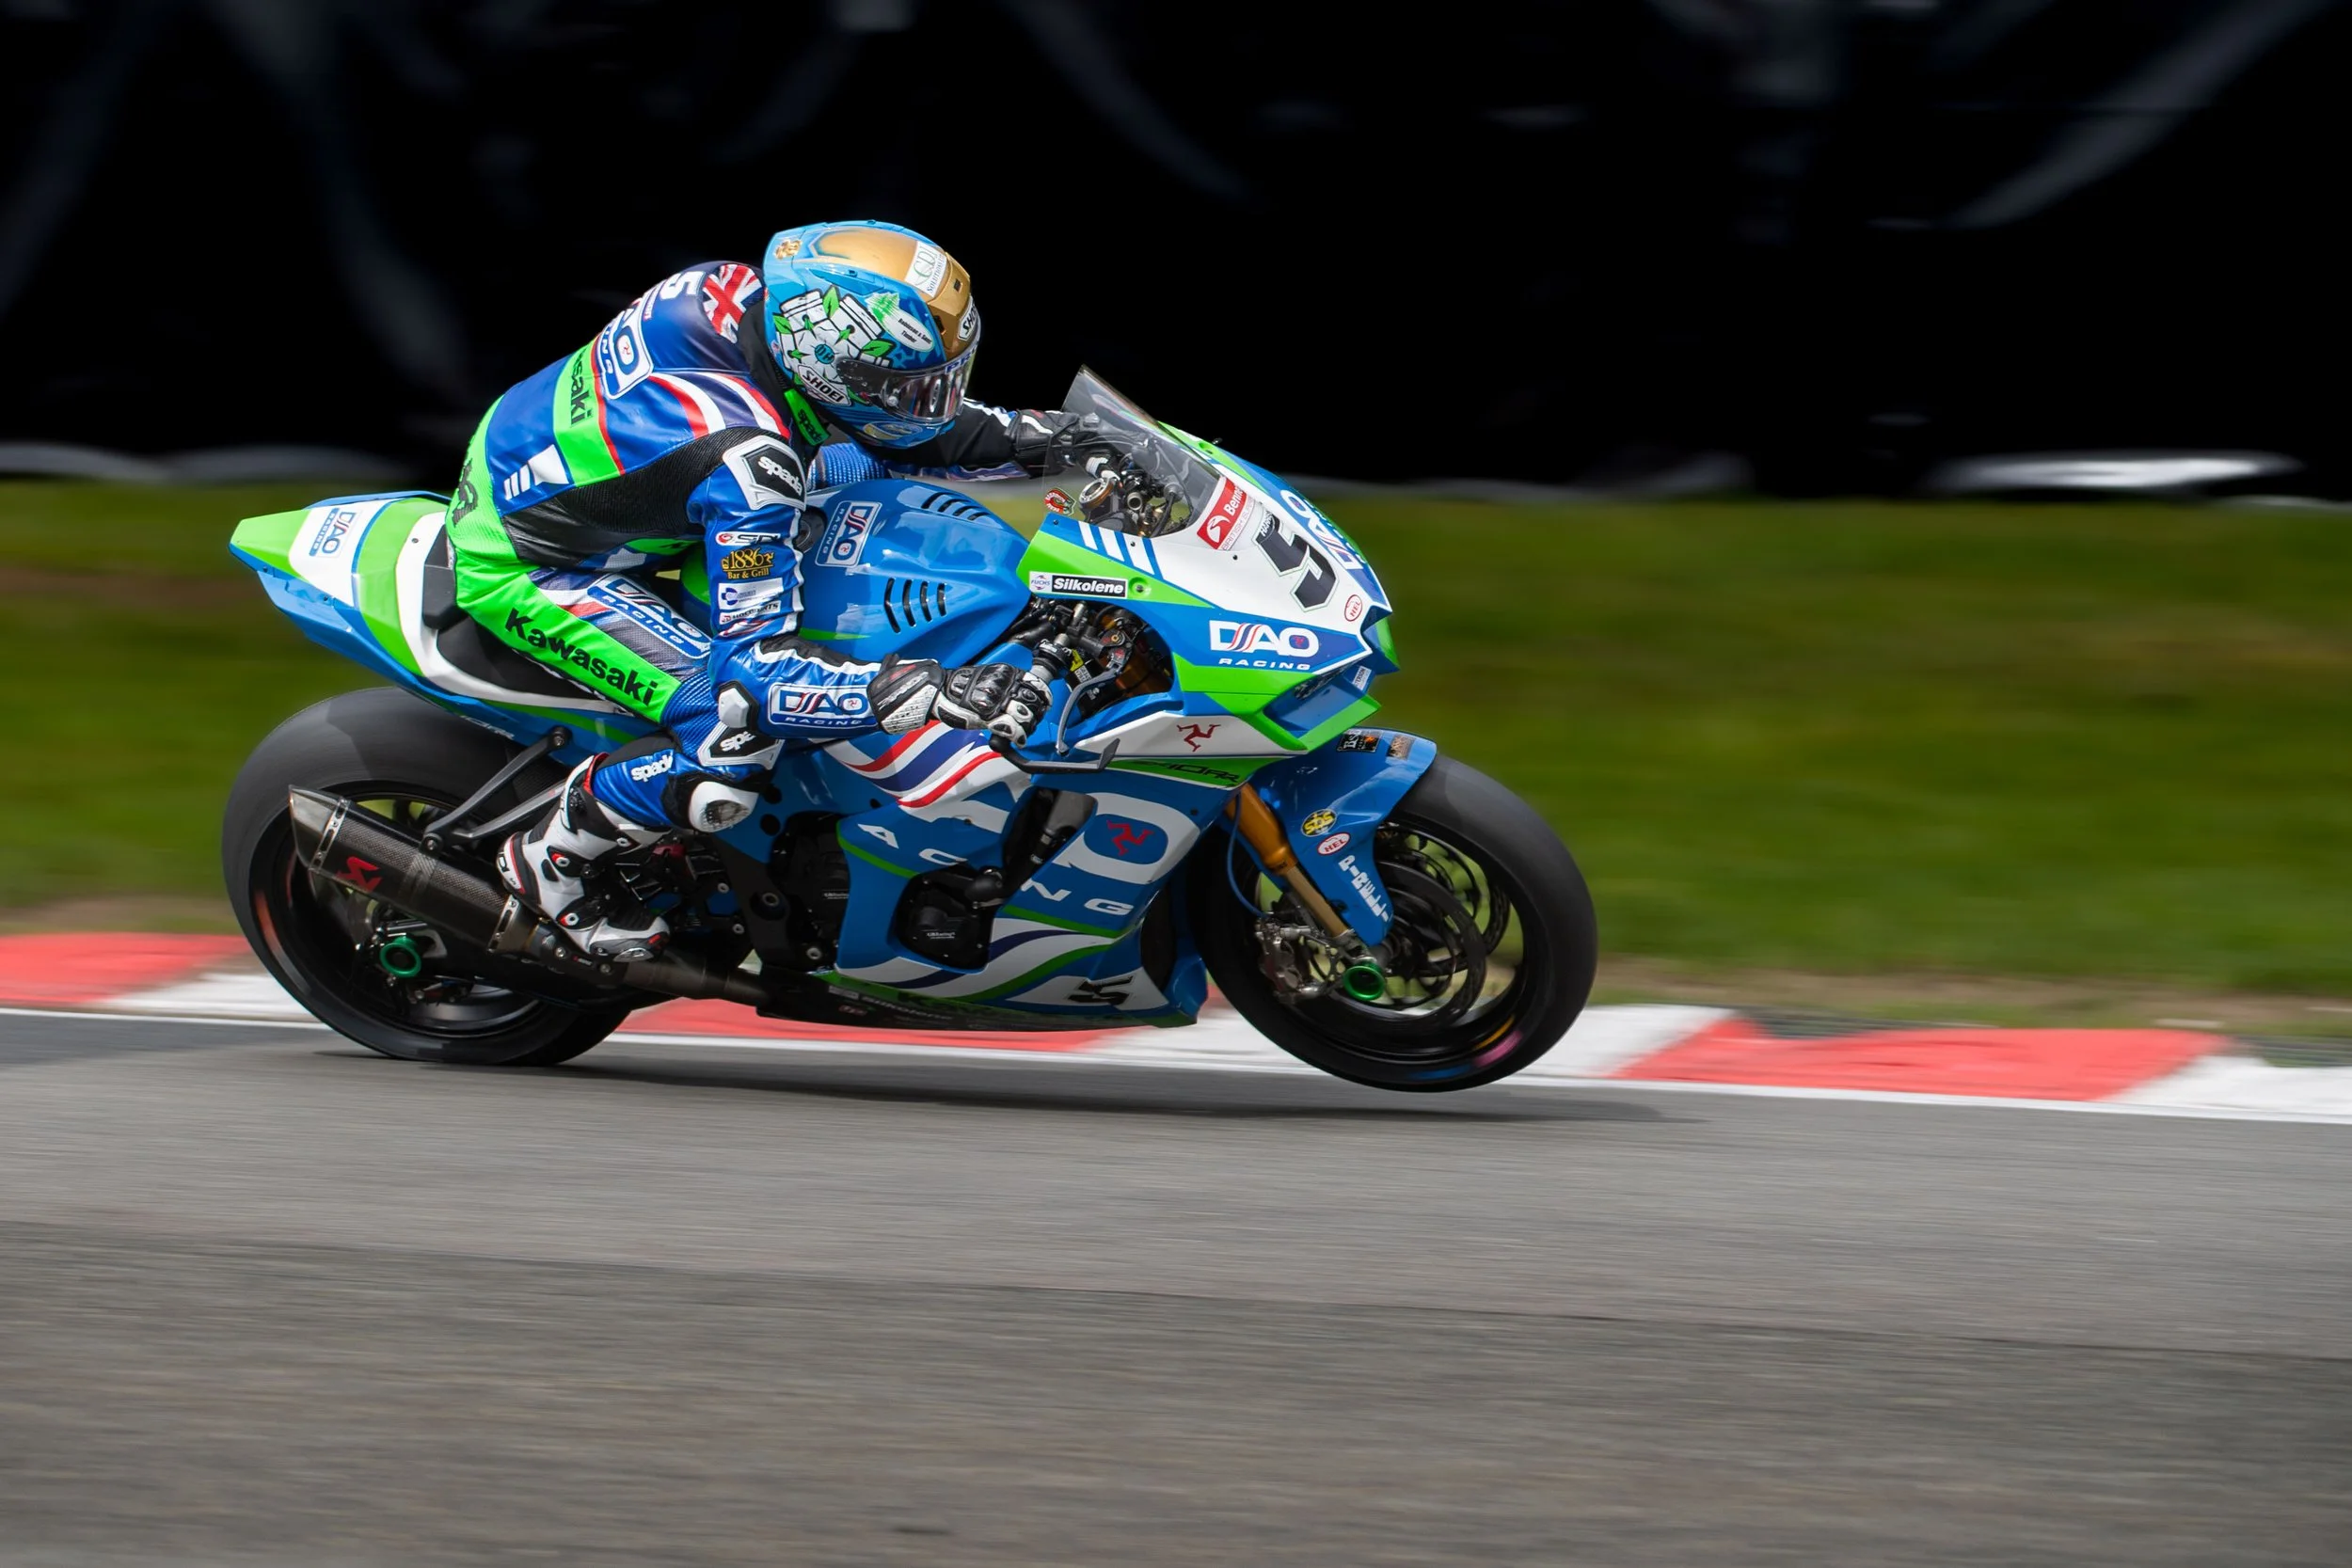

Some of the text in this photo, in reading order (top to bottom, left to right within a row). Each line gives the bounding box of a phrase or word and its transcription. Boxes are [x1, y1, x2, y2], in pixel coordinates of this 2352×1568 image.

[803, 369, 845, 402] SHOEI
[757, 455, 803, 496] spada
[313, 513, 336, 550] RACING
[322, 512, 357, 553] DAO
[822, 507, 846, 555] RACING
[832, 505, 874, 561] DAO
[727, 571, 739, 579] Bar
[751, 568, 770, 578] Grill
[729, 547, 765, 570] 1886
[1053, 578, 1124, 594] Silkolene
[601, 594, 685, 644] RACING
[605, 578, 711, 642] DAO
[504, 606, 660, 707] Kawasaki
[1209, 620, 1319, 657] DAO
[1218, 657, 1311, 672] RACING
[779, 690, 870, 716] DAO
[785, 716, 862, 726] RACING
[720, 730, 756, 752] spa
[1324, 839, 1346, 853] HEL
[1338, 855, 1390, 922] PIRELLI
